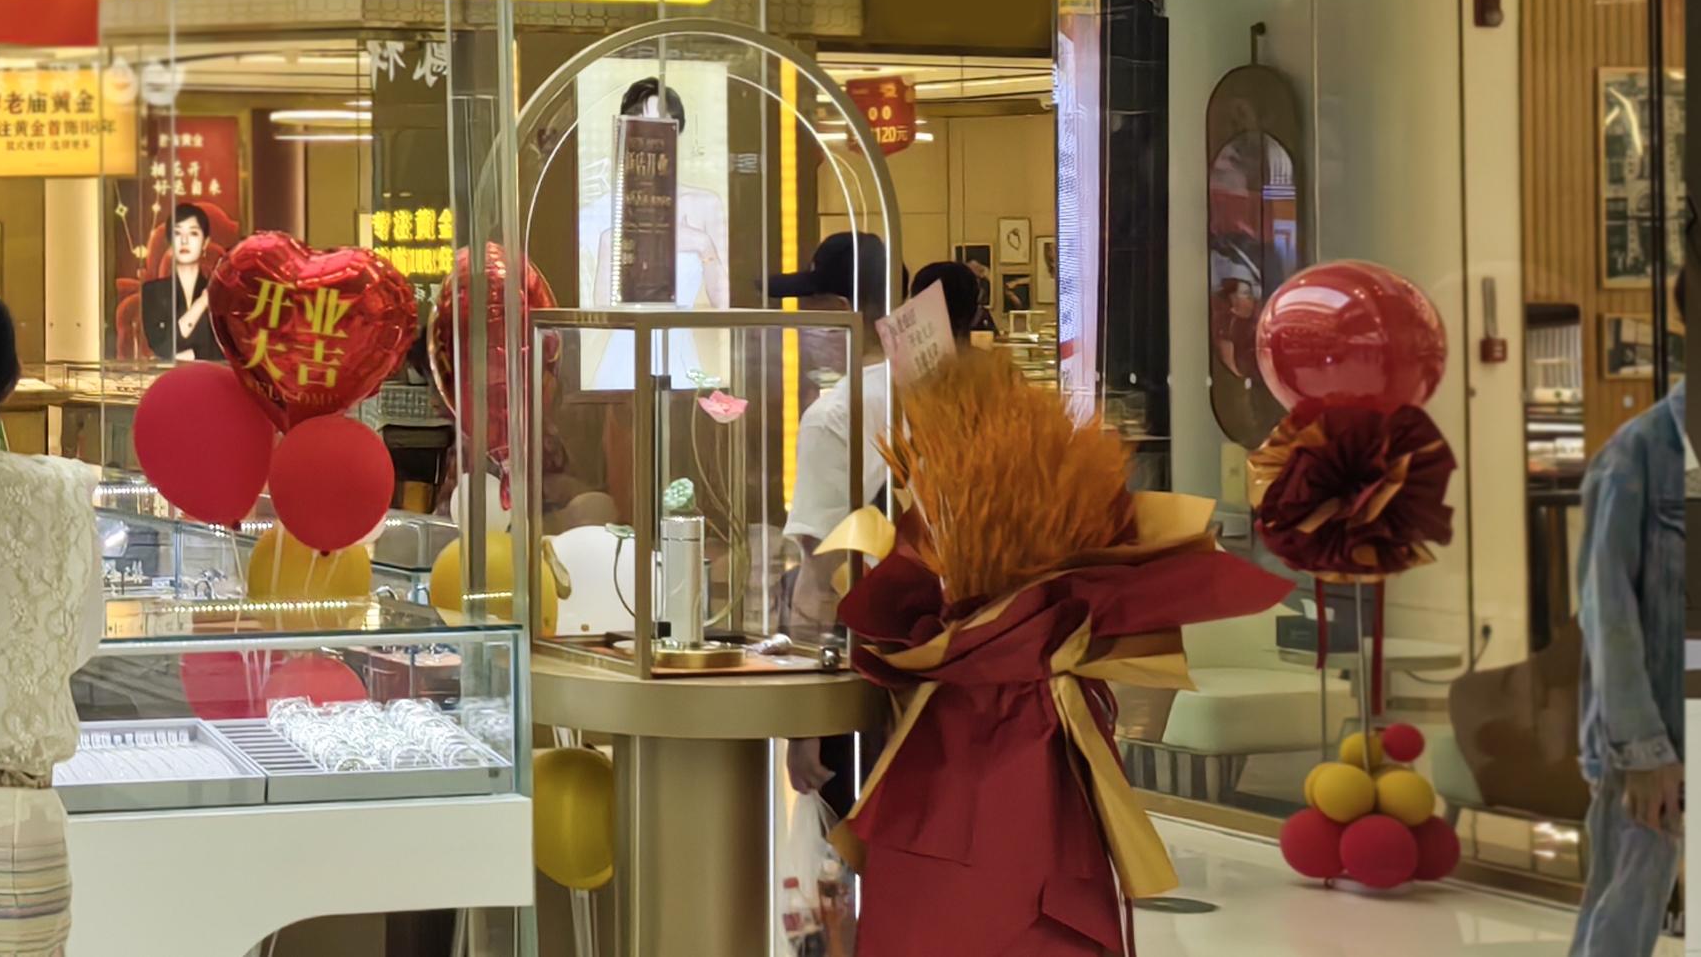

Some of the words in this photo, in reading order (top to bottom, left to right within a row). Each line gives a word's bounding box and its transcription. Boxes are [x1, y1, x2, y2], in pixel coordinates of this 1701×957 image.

[4, 90, 95, 115] 老庙黄金
[246, 276, 353, 338] 开业
[242, 328, 345, 388] 大吉
